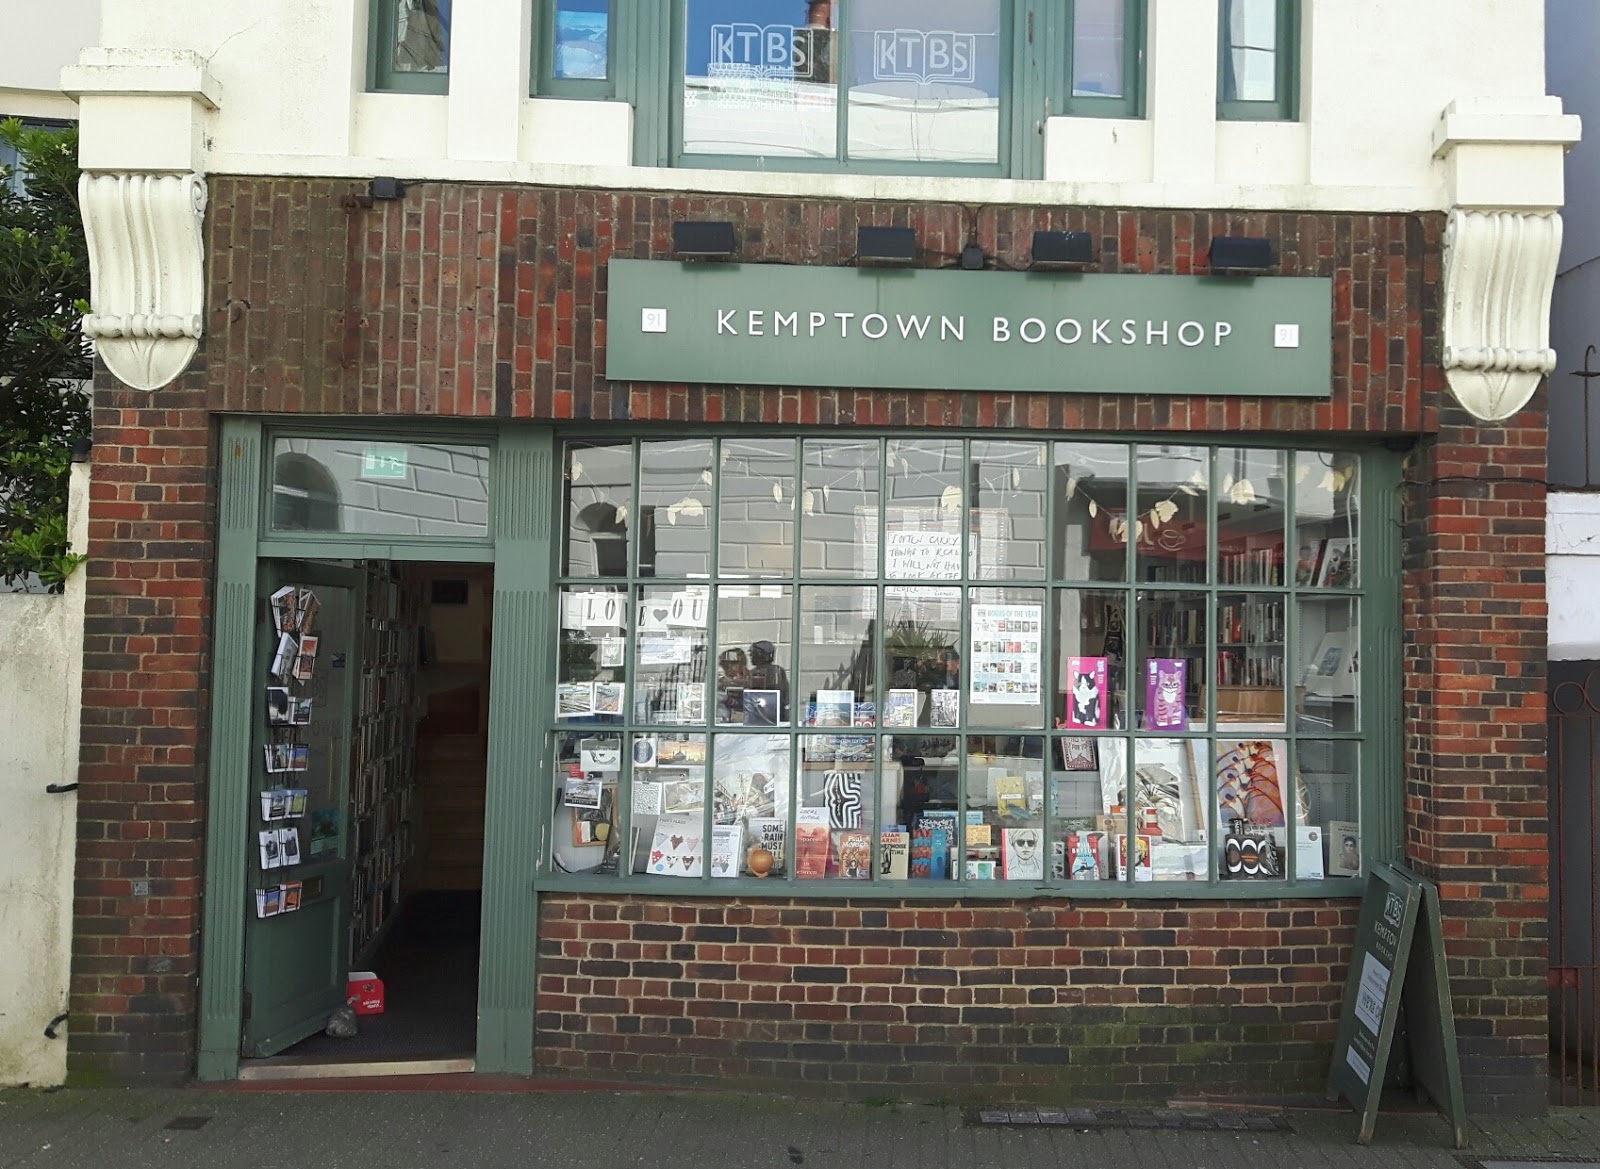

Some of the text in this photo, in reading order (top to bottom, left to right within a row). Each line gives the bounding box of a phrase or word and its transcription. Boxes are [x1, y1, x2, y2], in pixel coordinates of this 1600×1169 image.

[718, 31, 806, 67] KTBS
[880, 37, 968, 73] KTBS
[646, 312, 661, 326] 91
[717, 309, 1232, 347] KEMPTOWN BOOKSHOP
[920, 548, 930, 556] TO
[935, 548, 960, 557] READ
[902, 559, 925, 570] WILL
[926, 559, 941, 570] NOT
[762, 824, 783, 833] SOME
[764, 833, 783, 842] RAIN
[761, 842, 783, 850] MUST
